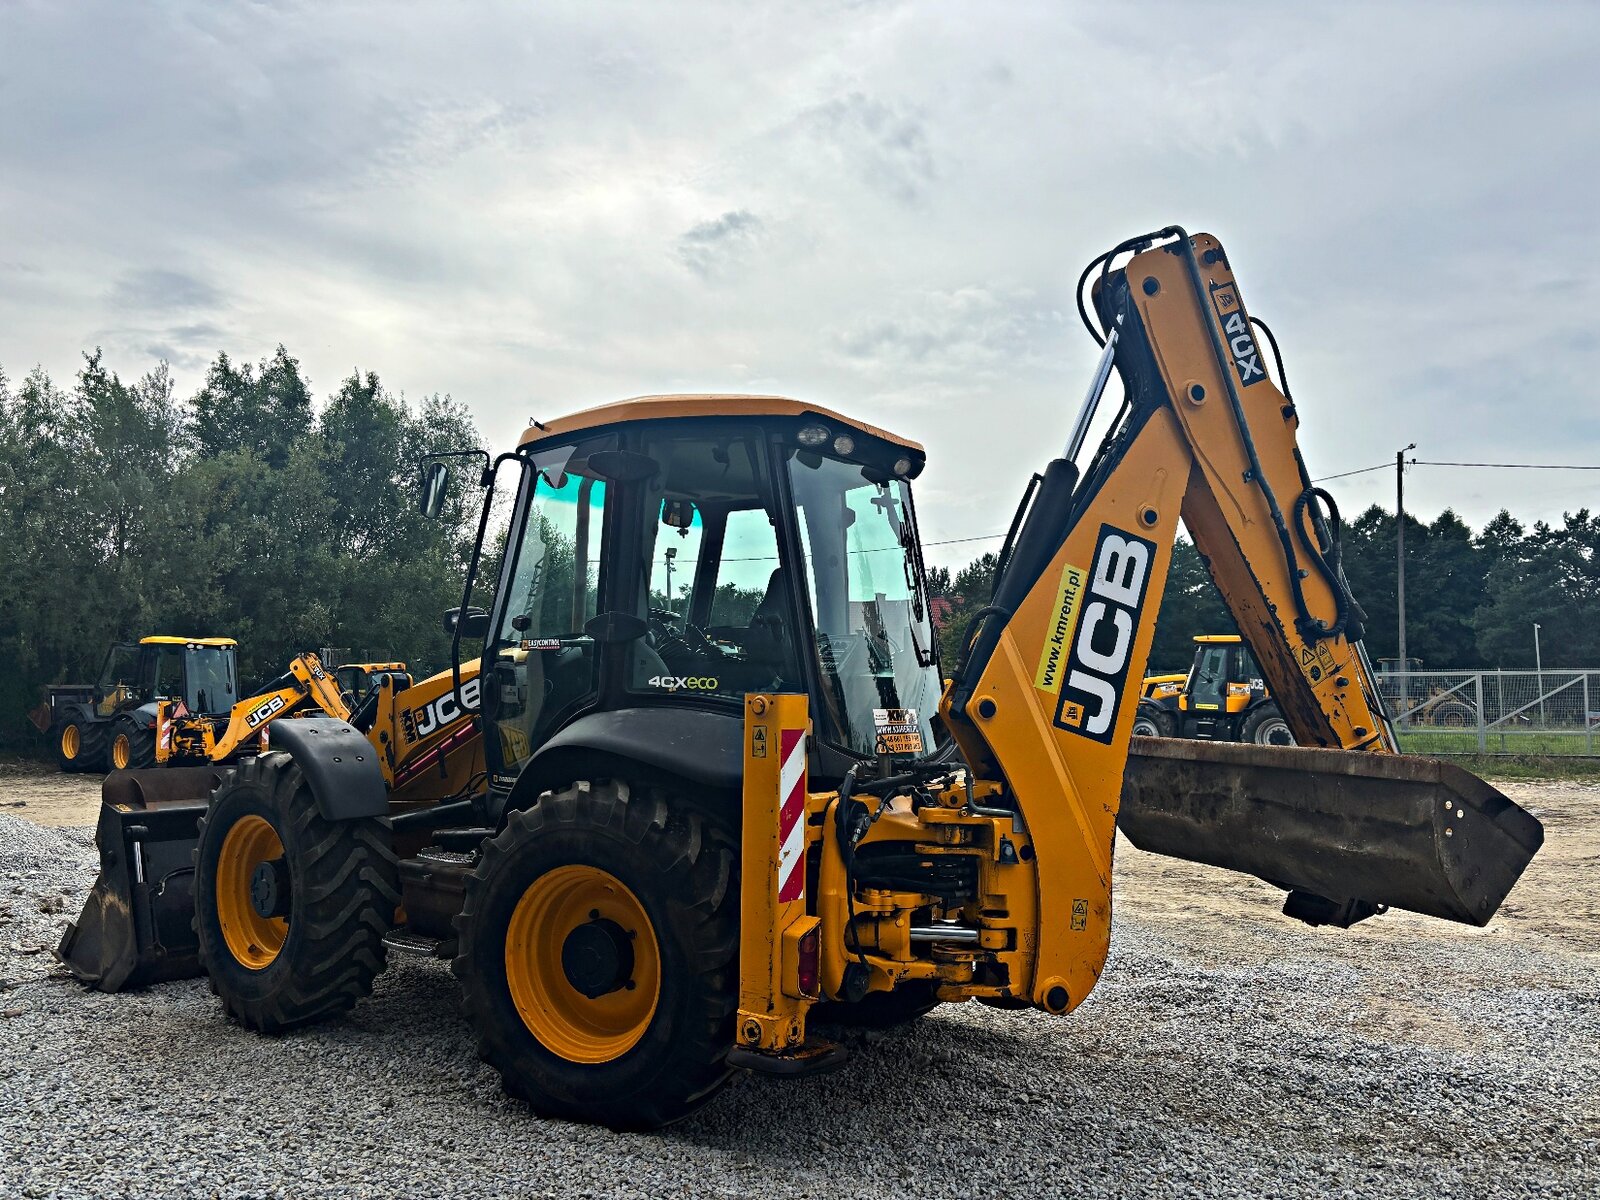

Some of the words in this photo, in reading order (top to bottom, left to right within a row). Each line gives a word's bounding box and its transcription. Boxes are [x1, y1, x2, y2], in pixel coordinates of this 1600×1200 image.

[1225, 312, 1264, 381] 4CX
[528, 638, 560, 648] EASYCONTROL
[1043, 569, 1081, 686] www.kmrent.pl
[1068, 534, 1149, 735] JCB
[248, 696, 285, 727] JCB
[418, 678, 481, 735] JCB
